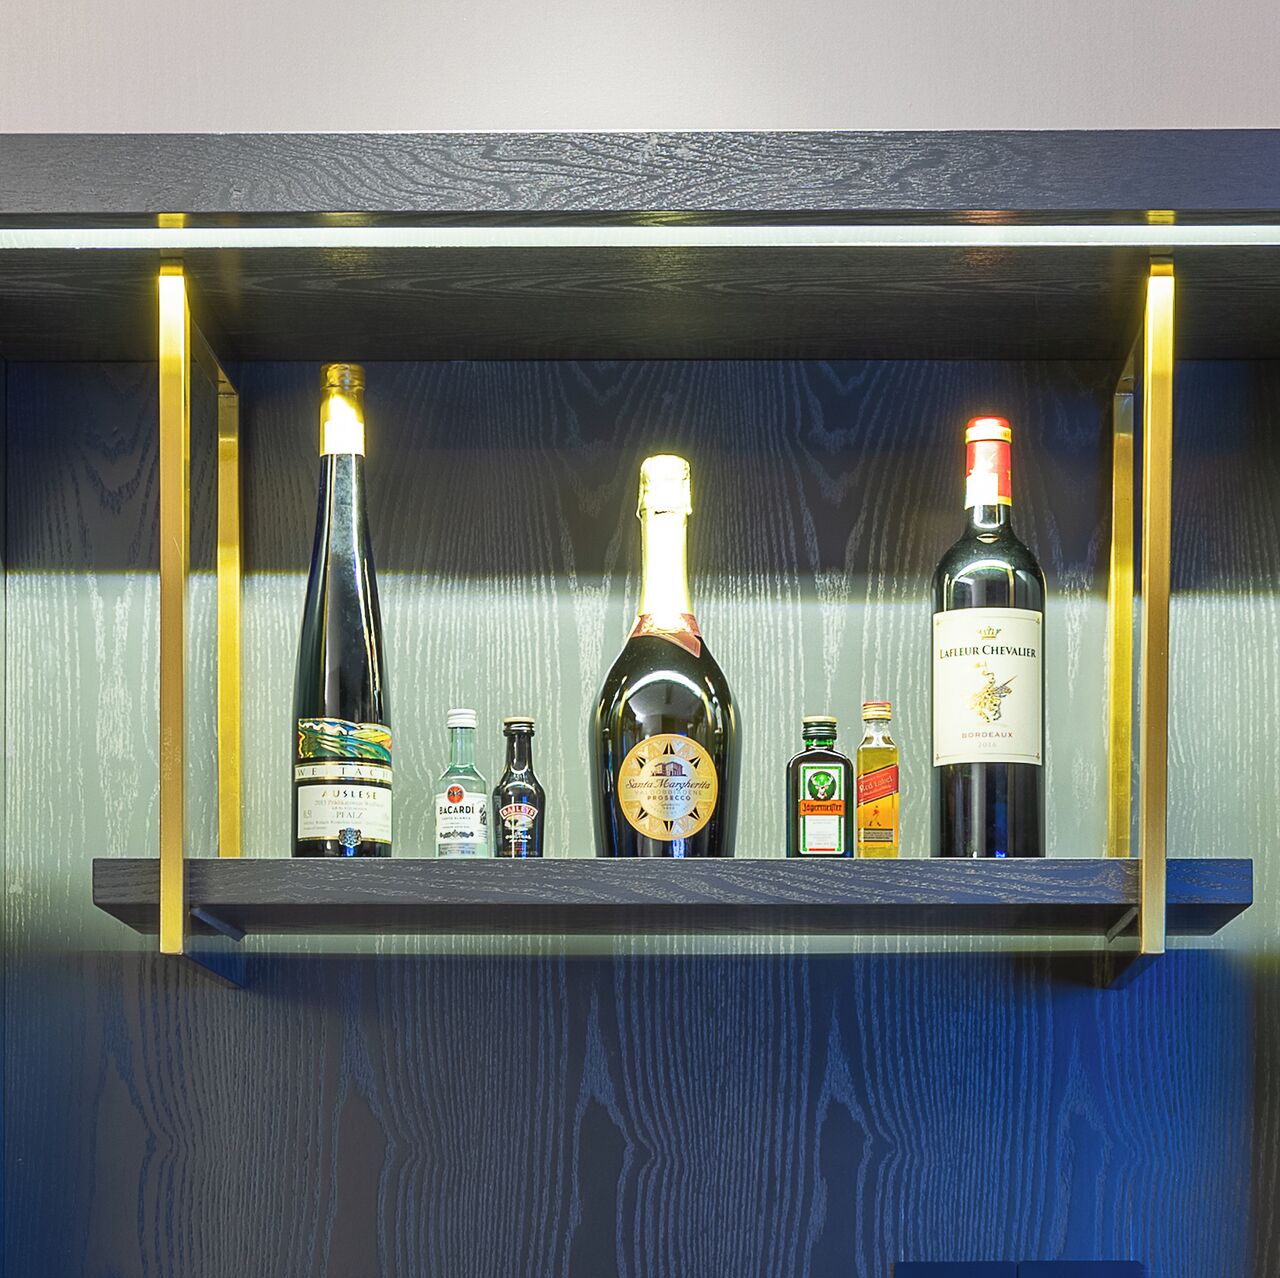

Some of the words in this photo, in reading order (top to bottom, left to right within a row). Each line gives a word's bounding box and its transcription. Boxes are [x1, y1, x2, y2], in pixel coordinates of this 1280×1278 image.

[940, 647, 980, 659] LAFLEUR
[982, 644, 1036, 658] CHEVALIER
[626, 779, 653, 790] Santa
[653, 778, 711, 791] Margherita
[502, 805, 535, 817] BAILEYS
